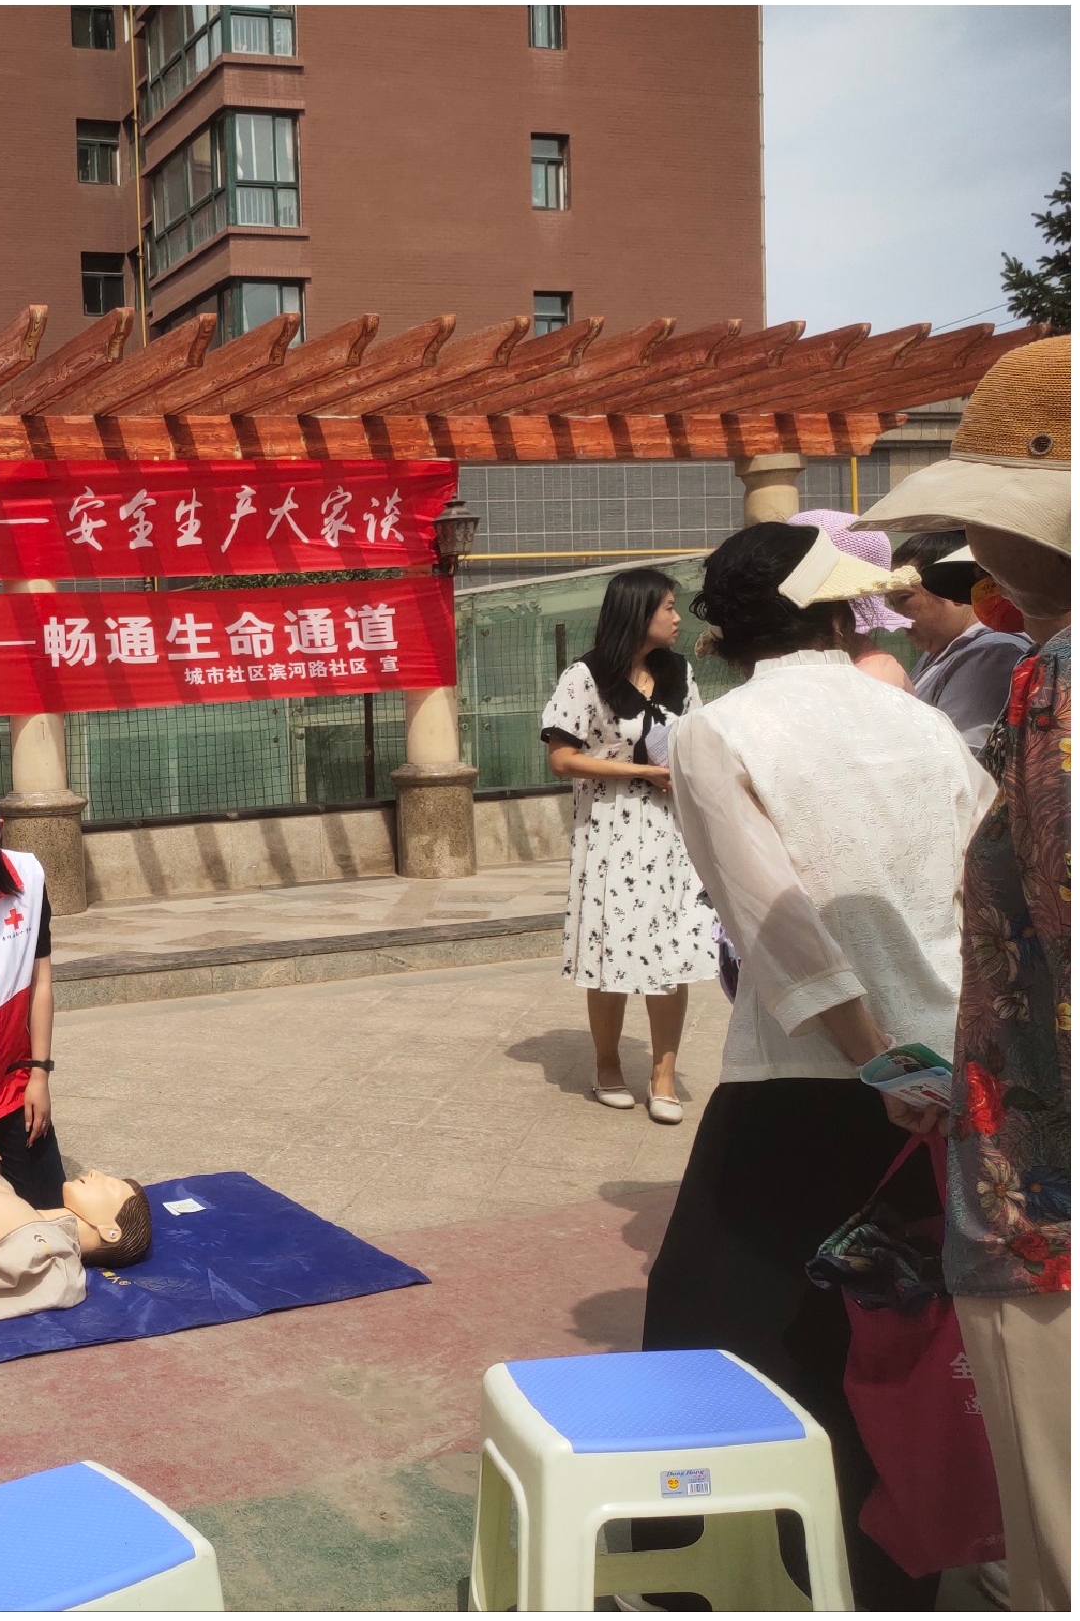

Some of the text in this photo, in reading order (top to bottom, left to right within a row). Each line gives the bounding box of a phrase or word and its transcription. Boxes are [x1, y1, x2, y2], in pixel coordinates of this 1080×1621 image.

[184, 655, 399, 685] 城市社区滨河路社区 宣
